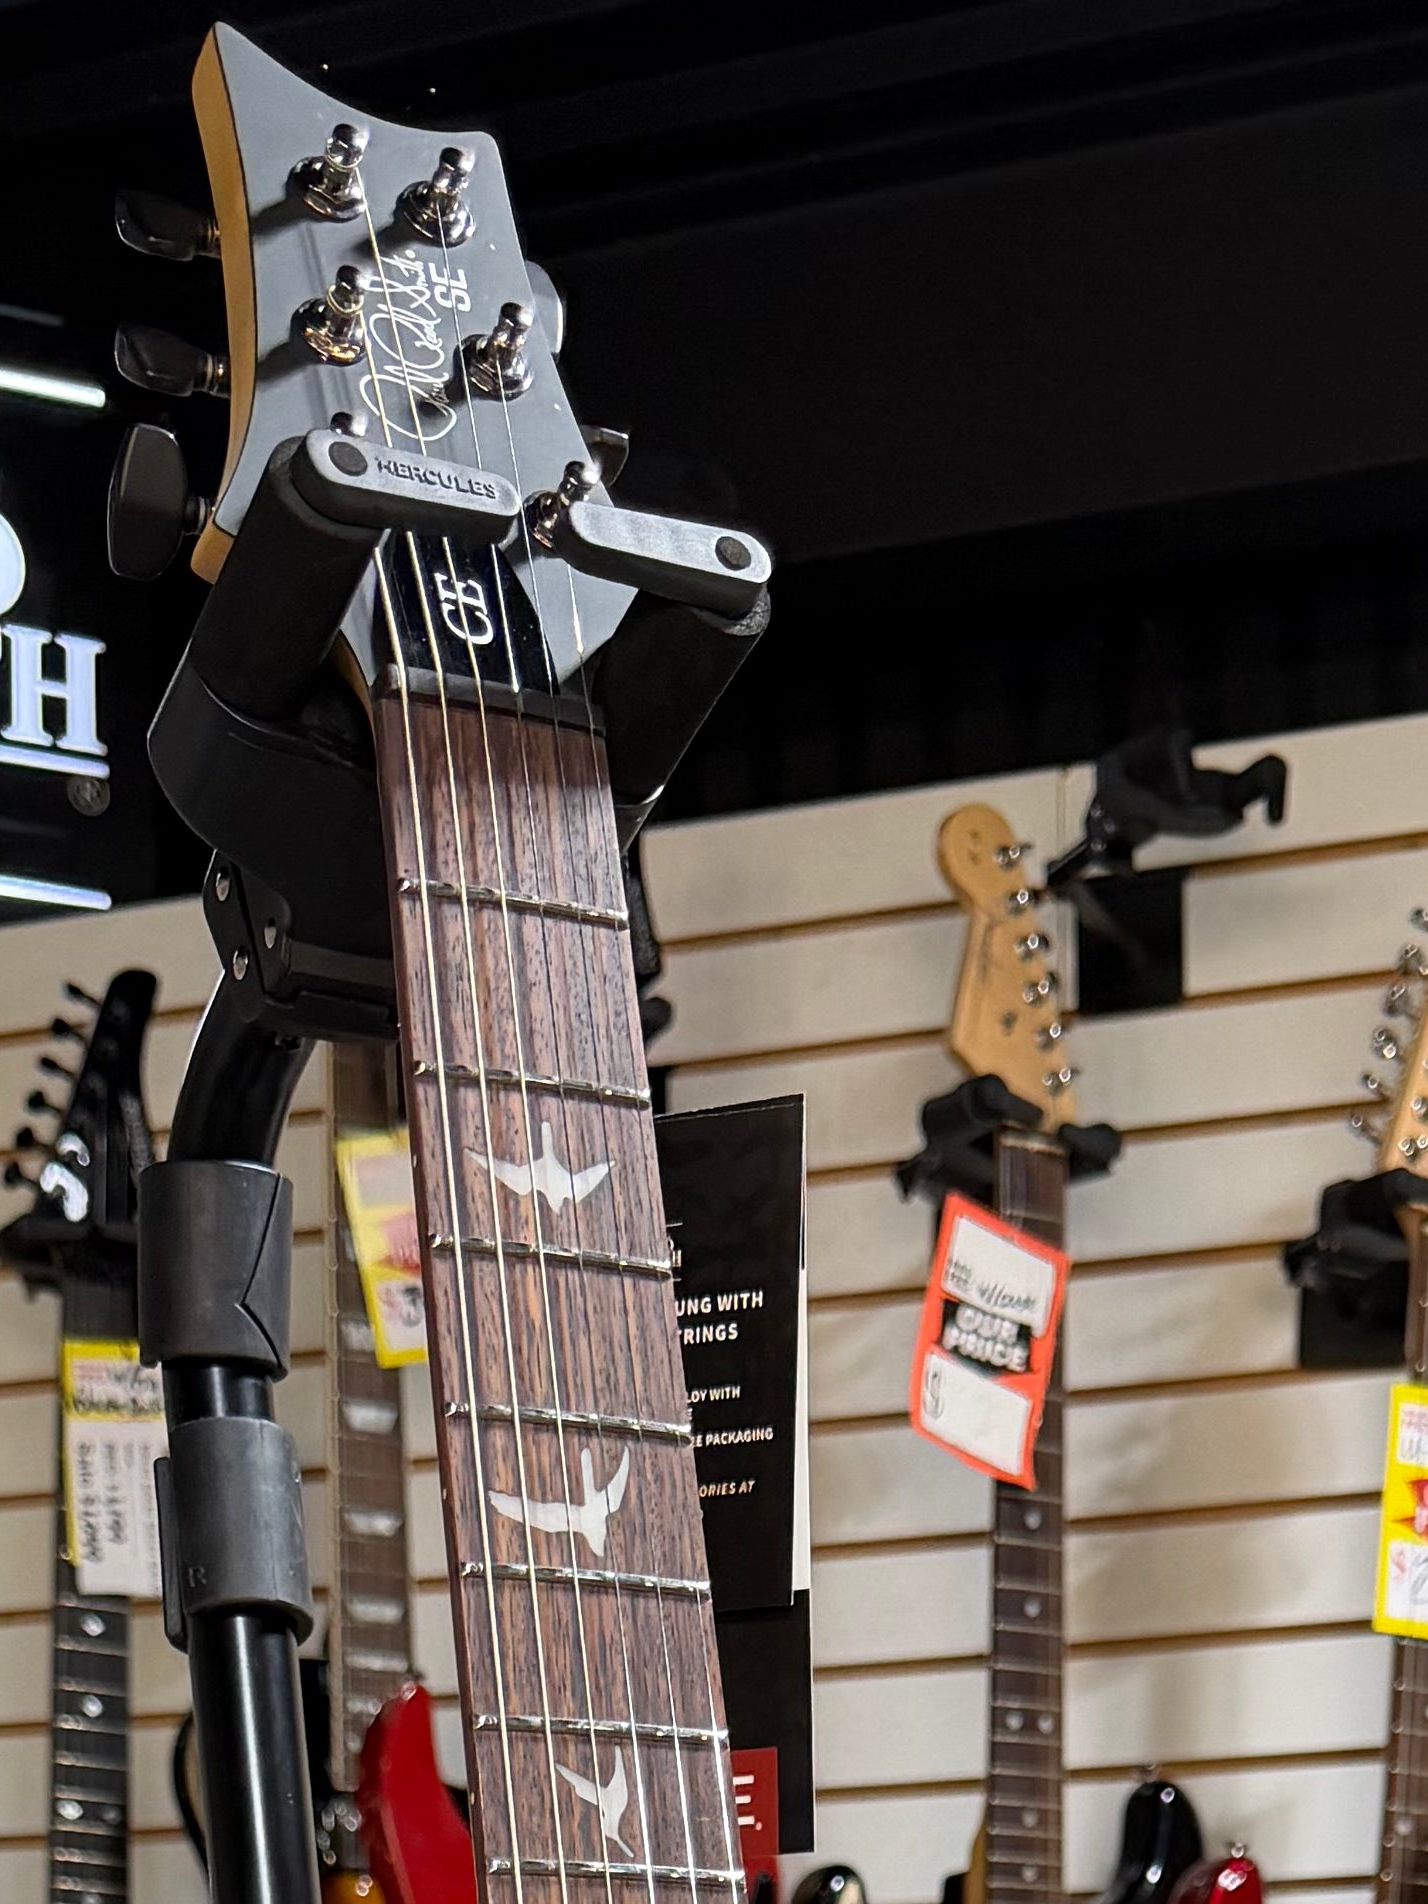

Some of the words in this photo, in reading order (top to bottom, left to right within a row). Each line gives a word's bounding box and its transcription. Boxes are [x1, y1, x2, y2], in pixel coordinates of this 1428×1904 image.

[429, 262, 472, 312] SE
[375, 456, 497, 499] HERCULES
[677, 1294, 712, 1317] UNG
[717, 1290, 764, 1313] WITH
[679, 1322, 739, 1346] RINGS
[955, 1303, 1019, 1346] OUR
[942, 1325, 1028, 1373] PRICE
[709, 1384, 741, 1401] WITH
[705, 1426, 774, 1449] PACKAGING
[699, 1481, 736, 1498] ORIES
[738, 1479, 756, 1494] AT
